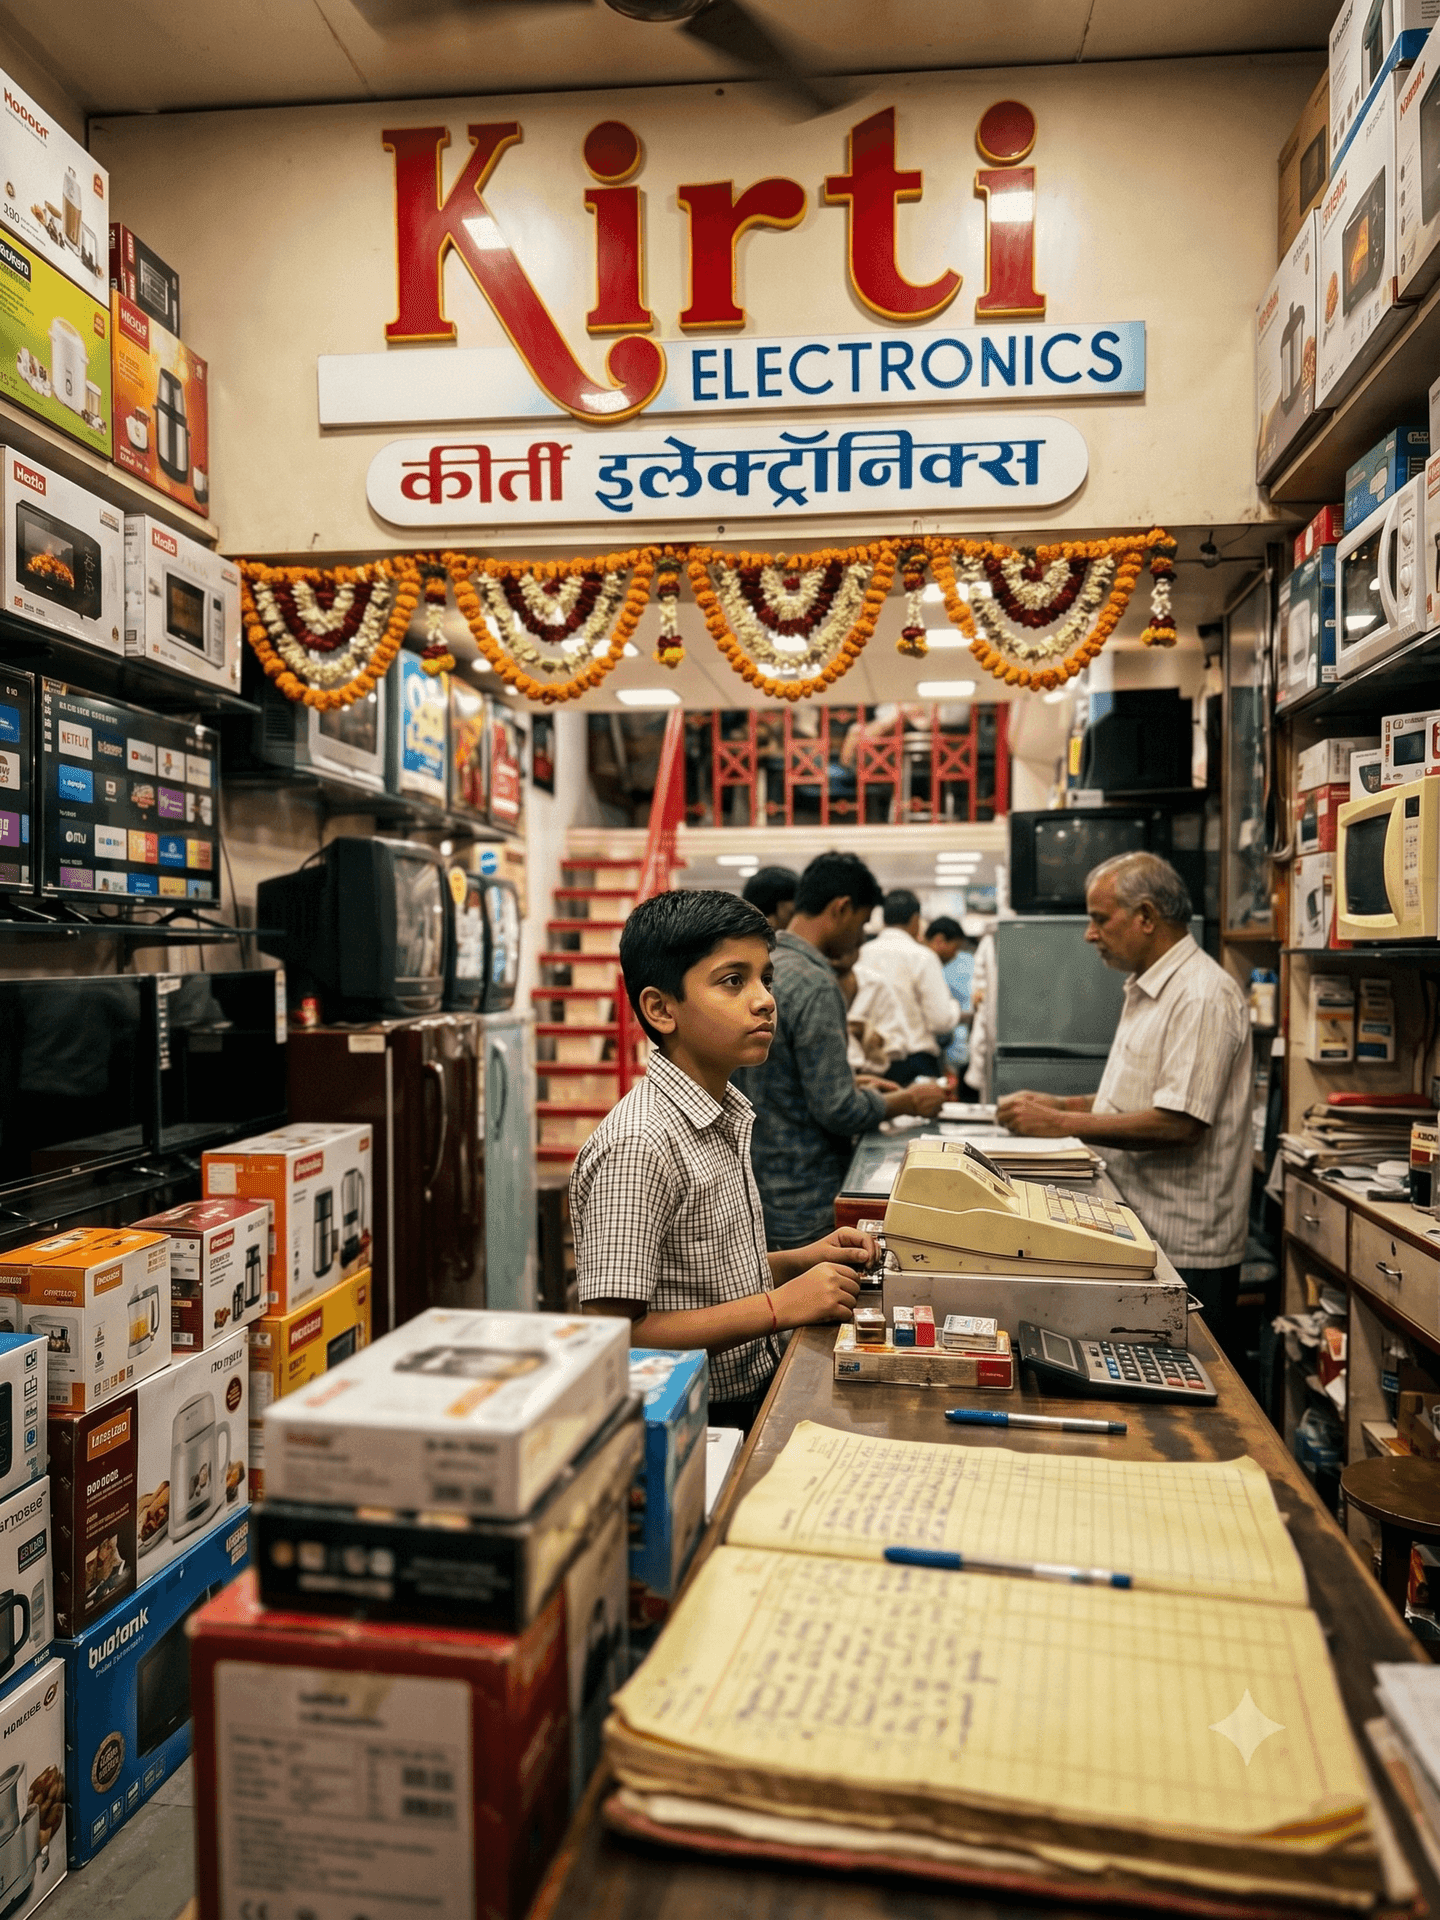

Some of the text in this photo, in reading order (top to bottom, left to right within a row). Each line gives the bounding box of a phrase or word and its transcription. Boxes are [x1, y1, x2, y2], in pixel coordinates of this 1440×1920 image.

[382, 100, 1046, 423] Kirti
[691, 331, 1123, 401] ELECTRONICS
[400, 429, 1046, 512] कीर्ती इलेक्ट्रॉनिक्स
[61, 731, 90, 750] NETFLIX
